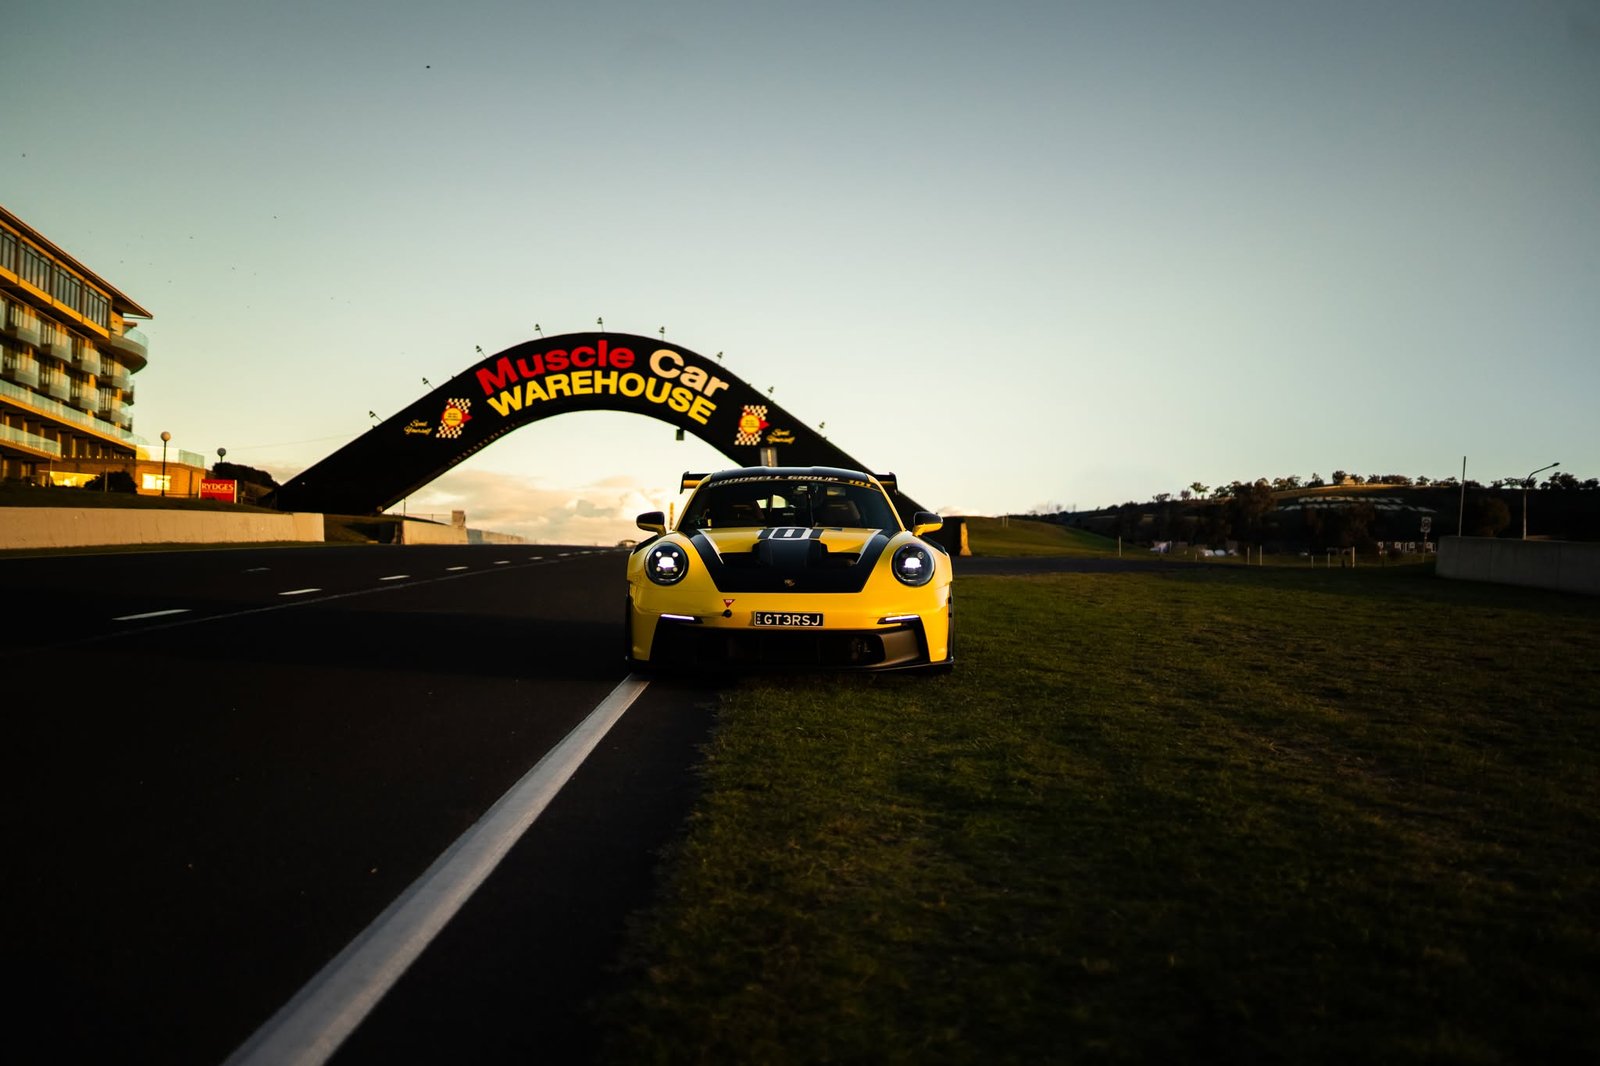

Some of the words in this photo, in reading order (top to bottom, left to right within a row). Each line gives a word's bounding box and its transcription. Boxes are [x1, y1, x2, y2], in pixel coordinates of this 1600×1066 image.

[475, 339, 635, 396] Muscle
[649, 348, 730, 398] Car
[486, 370, 717, 425] WAREHOUSE
[201, 483, 234, 491] RYDGES
[763, 613, 821, 626] GT3RSJ
